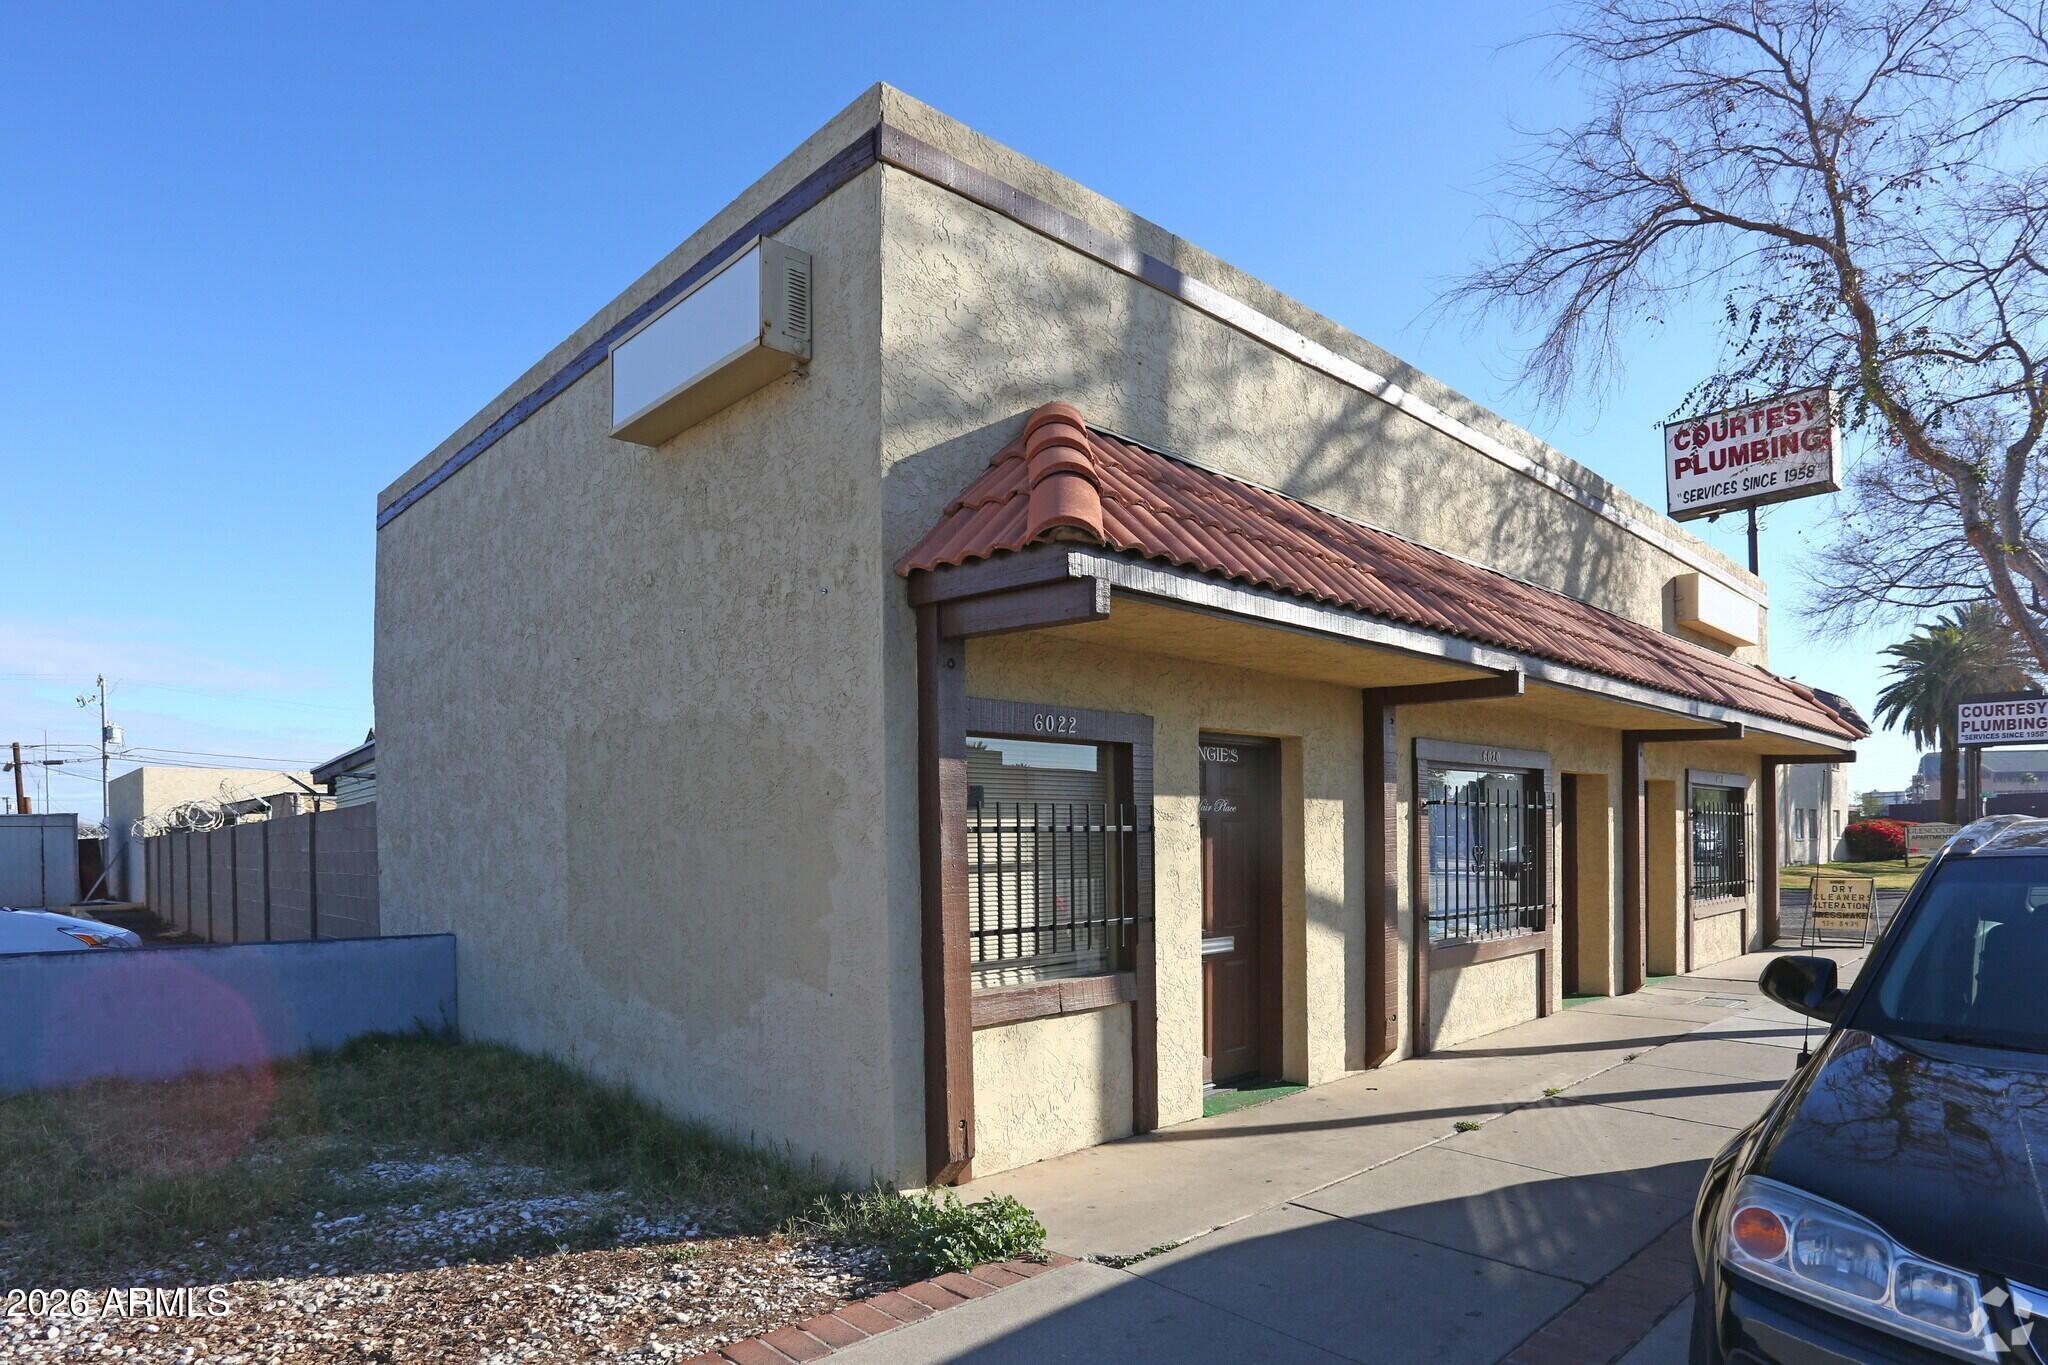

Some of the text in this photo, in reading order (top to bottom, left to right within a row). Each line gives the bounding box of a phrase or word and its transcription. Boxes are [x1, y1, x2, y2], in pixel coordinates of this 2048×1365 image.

[1673, 396, 1821, 451] COURTESY
[1674, 425, 1822, 480] PLUMBING
[1742, 471, 1777, 491] SINCE
[1961, 702, 2047, 718] COURTESY
[1034, 713, 1077, 734] 6022
[1961, 717, 2048, 733] PLUMBING
[2001, 731, 2024, 739] SINCE
[1198, 746, 1239, 763] NGIE'S
[1213, 798, 1237, 813] Place
[1831, 885, 1853, 893] DRY
[1812, 901, 1872, 910] ALTERATION
